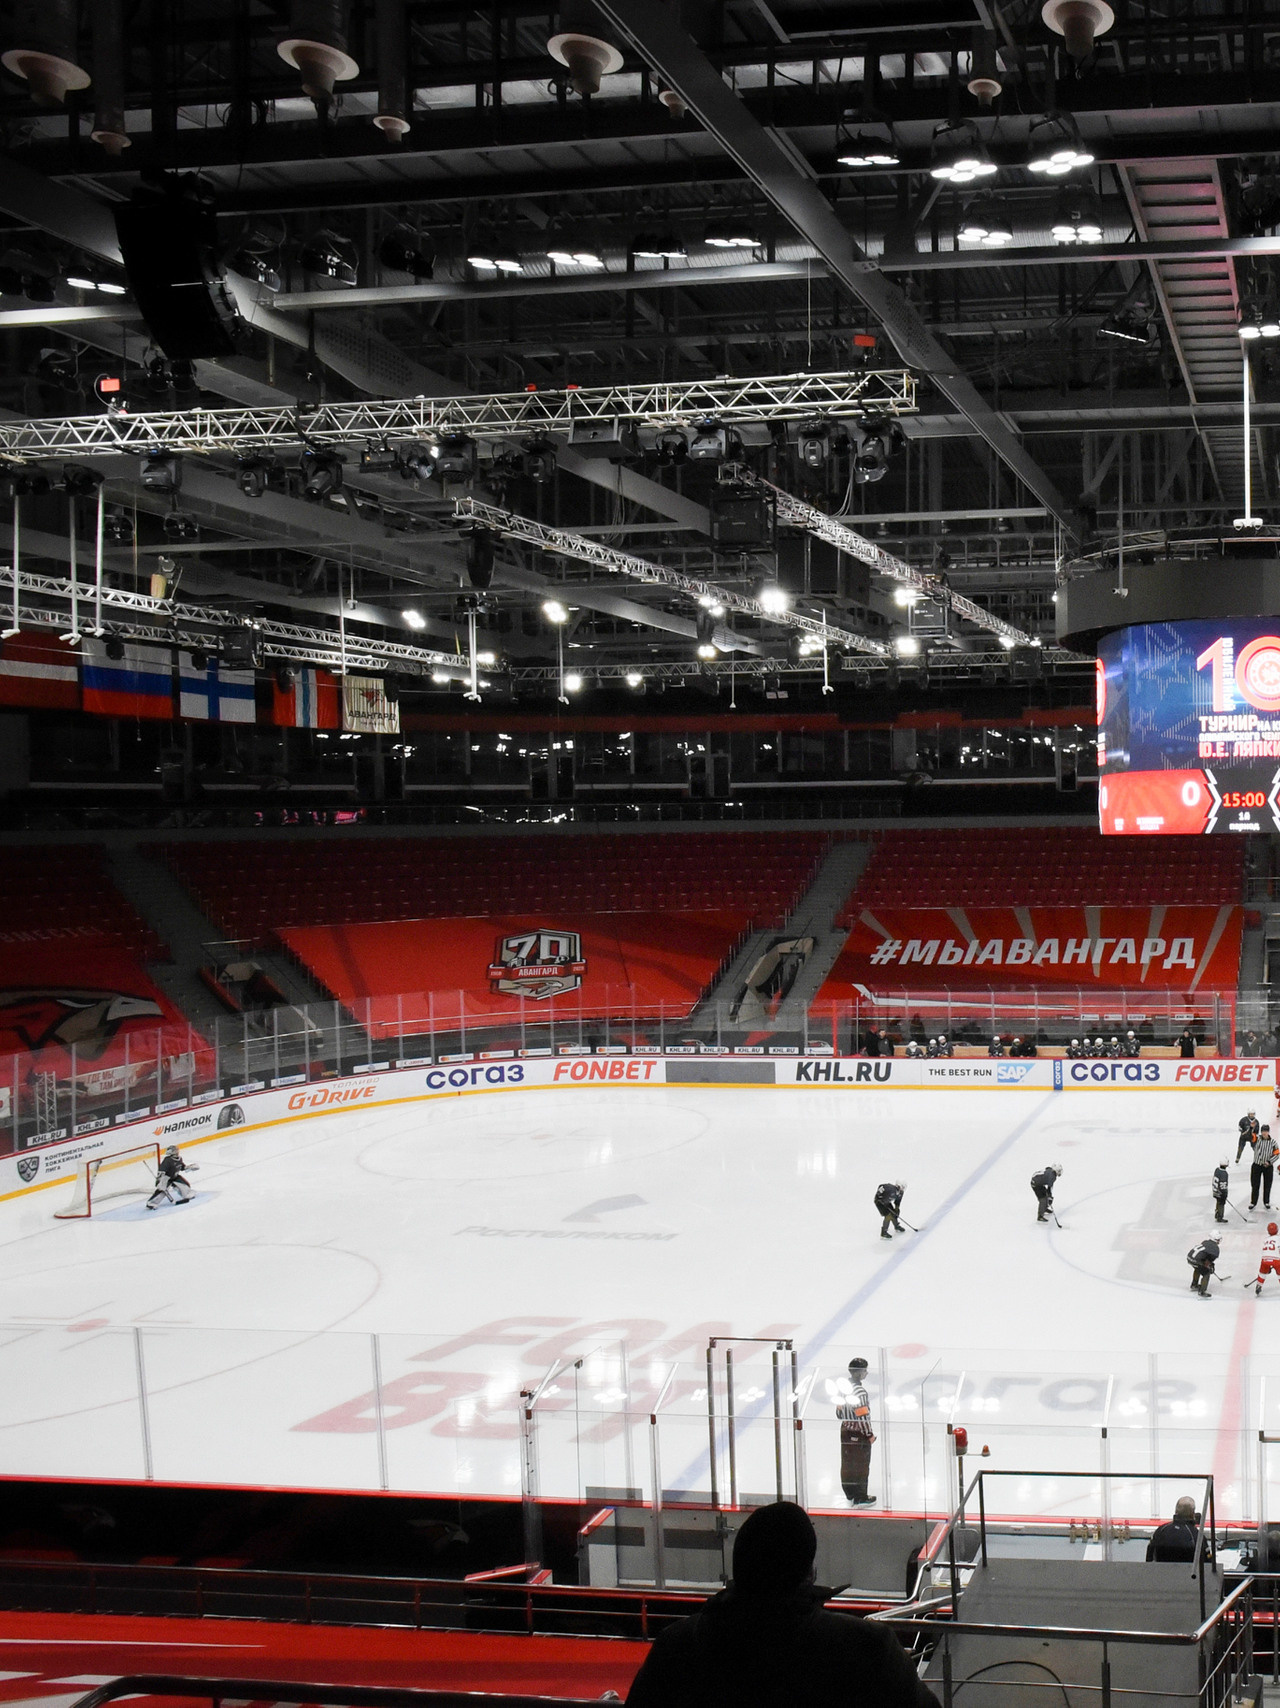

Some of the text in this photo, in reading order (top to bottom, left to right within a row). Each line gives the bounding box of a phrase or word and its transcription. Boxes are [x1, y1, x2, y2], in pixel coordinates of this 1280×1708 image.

[1198, 714, 1259, 732] ТУРНИР
[1258, 720, 1271, 732] НА
[1198, 741, 1230, 758] Ю.Е.
[1182, 780, 1201, 807] 0
[1222, 792, 1266, 808] 15:00
[869, 937, 1196, 969] #МЫАВАНГАРД
[518, 966, 558, 977] АВАНГАРД
[426, 1064, 525, 1090] согаз
[553, 1060, 657, 1082] FONBET
[795, 1061, 892, 1082] KHL.RU
[928, 1068, 993, 1077] THE BEST RUN
[997, 1063, 1027, 1081] SAP
[1070, 1062, 1160, 1082] согаз
[1175, 1064, 1269, 1082] FONBET
[332, 1077, 380, 1089] ТОПЛИВО
[78, 1119, 105, 1132] KHL.RU
[32, 1131, 62, 1145] KHL.RU
[453, 1225, 680, 1242] Ростелеком
[404, 1315, 800, 1371] FON
